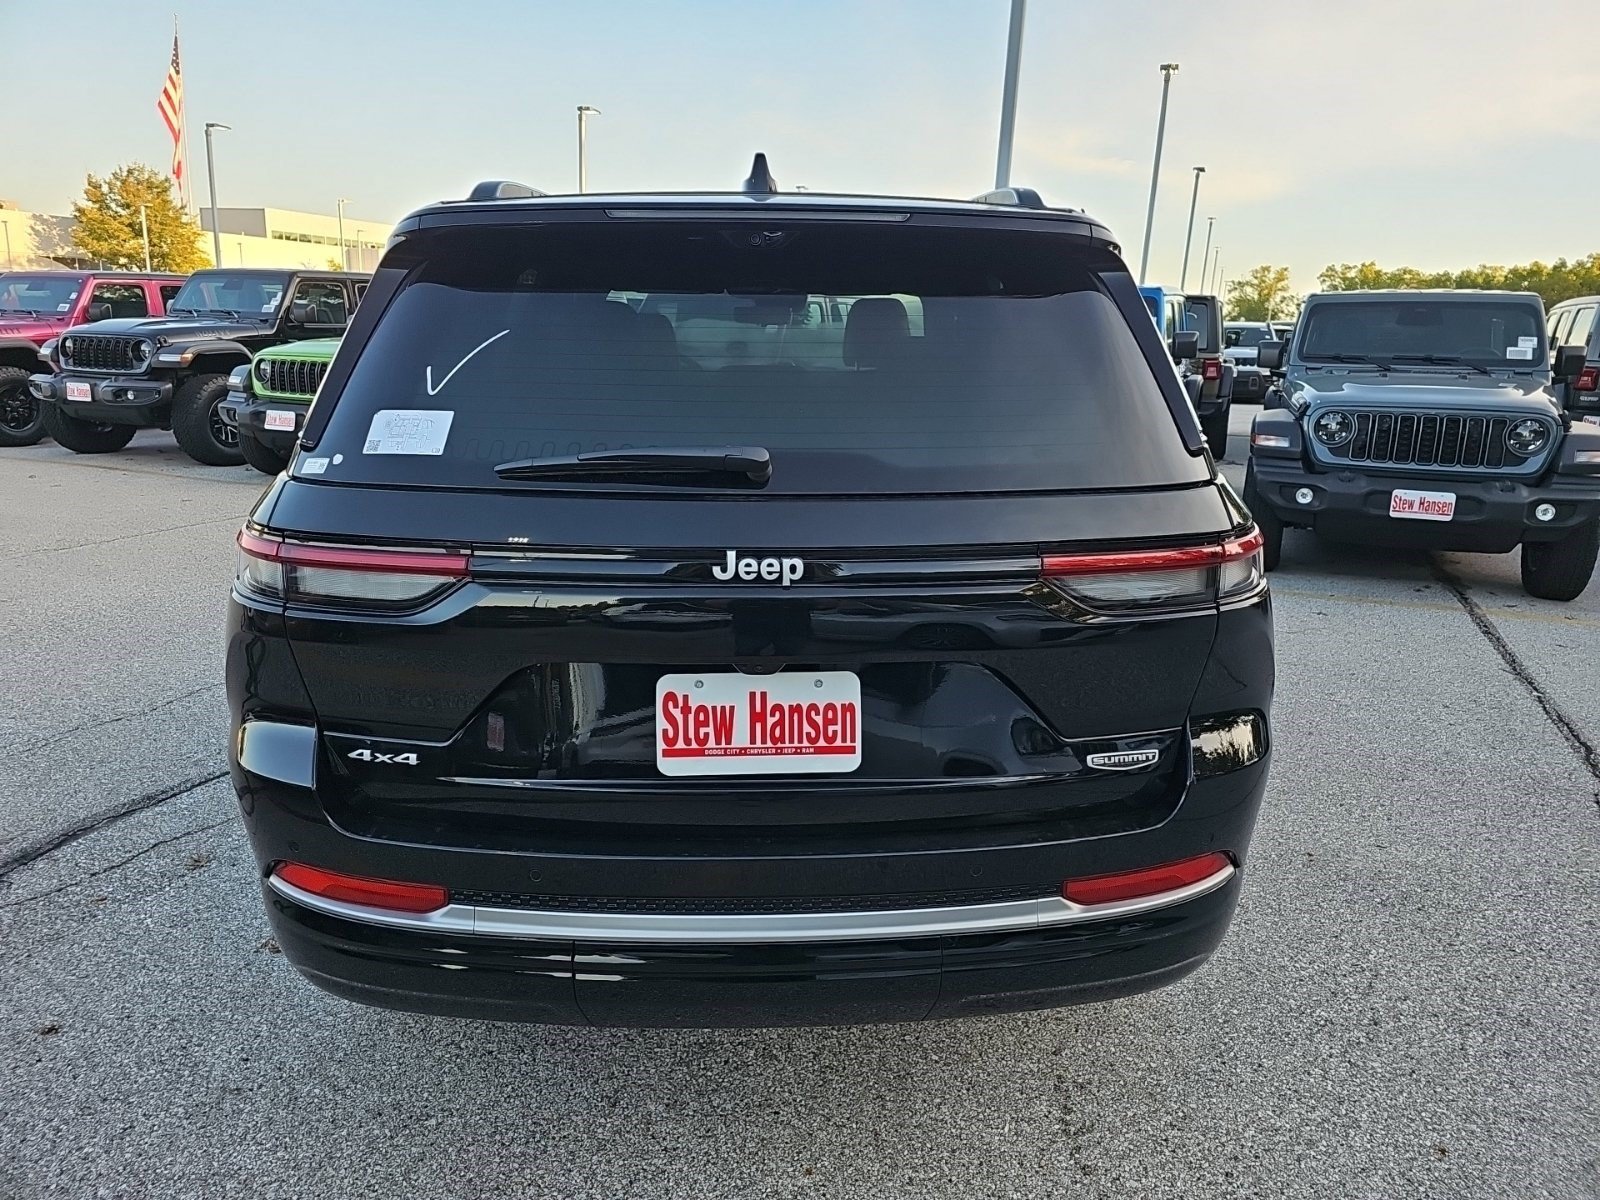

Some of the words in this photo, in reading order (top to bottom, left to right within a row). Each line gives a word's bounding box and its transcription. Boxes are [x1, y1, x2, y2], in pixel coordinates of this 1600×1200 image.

[1392, 494, 1415, 511] Stew
[1418, 496, 1453, 514] Hansen
[712, 550, 804, 586] Jeep
[662, 691, 735, 748] Stew
[749, 691, 856, 746] Hansen
[347, 749, 421, 765] 4x4
[1092, 753, 1156, 765] SUMMIT
